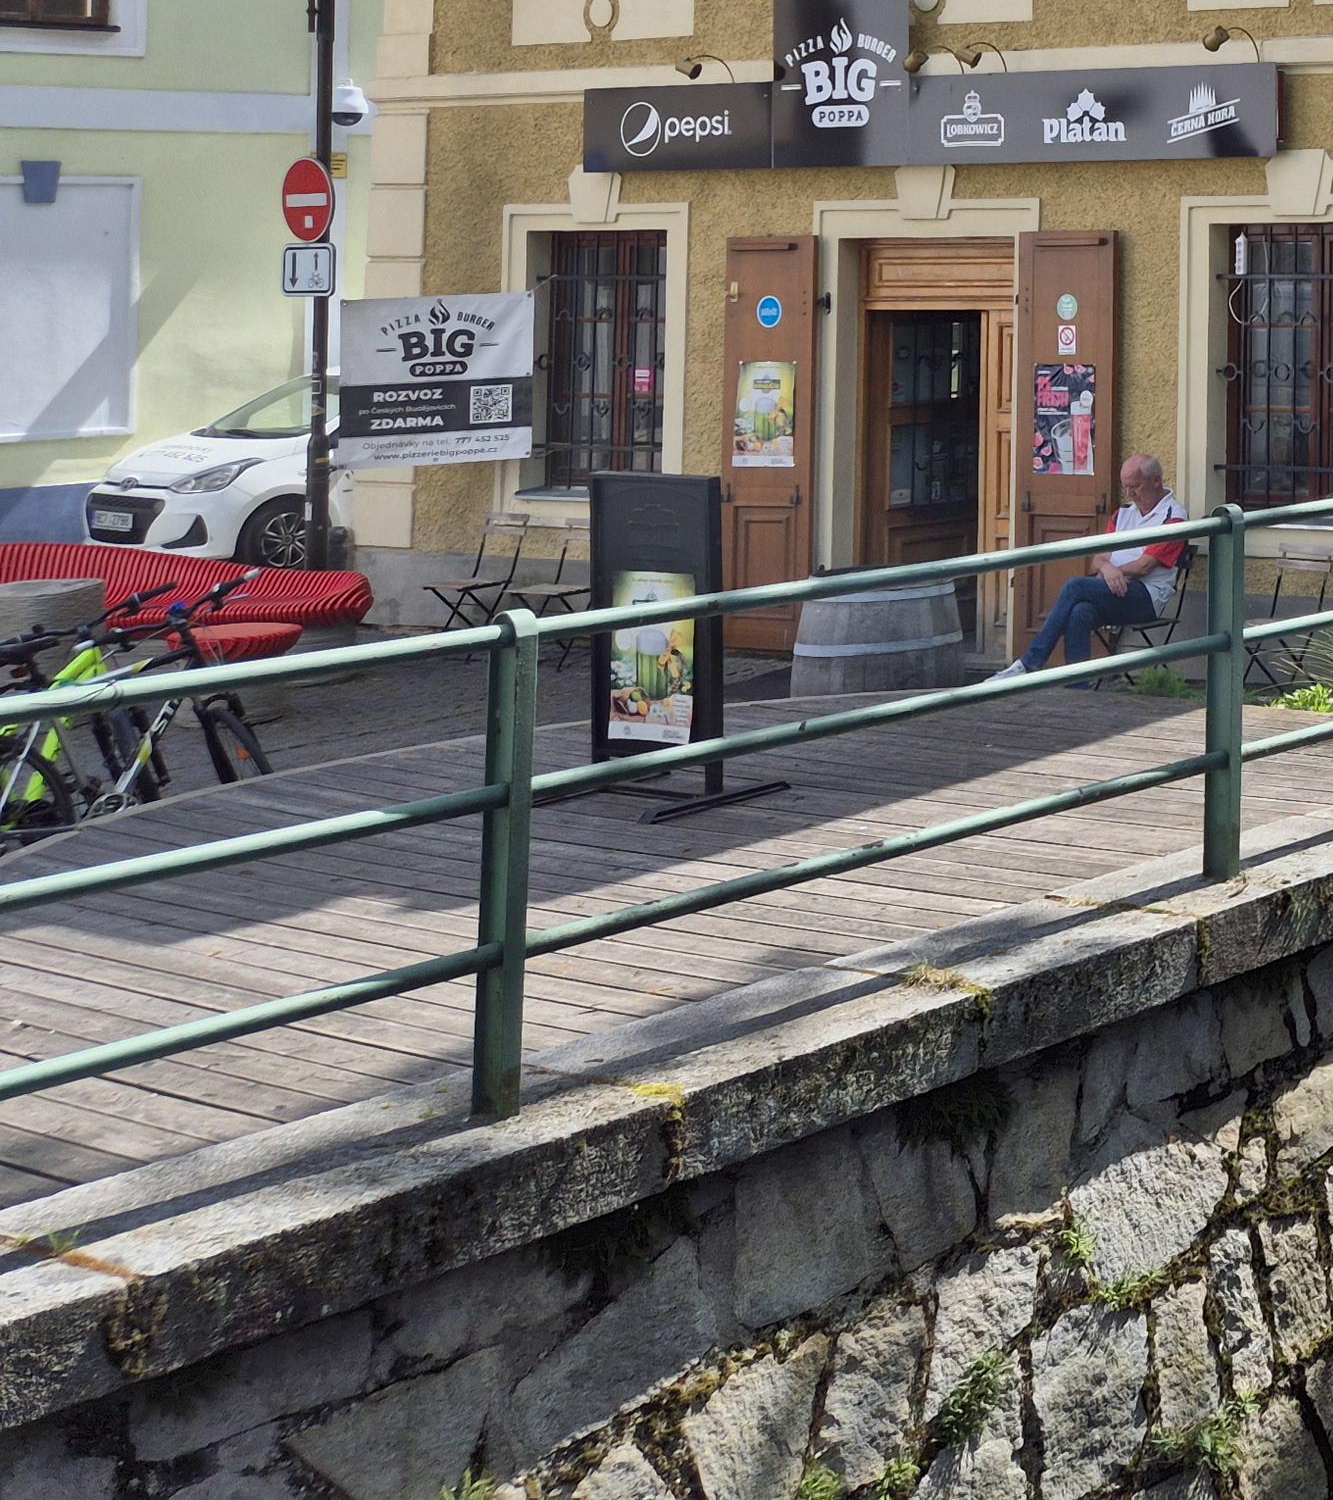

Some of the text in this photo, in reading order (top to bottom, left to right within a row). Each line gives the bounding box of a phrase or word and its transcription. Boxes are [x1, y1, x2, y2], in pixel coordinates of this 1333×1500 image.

[784, 33, 897, 68] PIZZA BURGER
[800, 56, 878, 106] BIG
[664, 110, 731, 144] pepsi
[817, 110, 864, 124] POPPA
[1207, 105, 1237, 126] HORA
[946, 122, 999, 138] LOBKOWICZ
[1042, 117, 1128, 144] Platan
[380, 311, 496, 336] PIZZA BURGER
[398, 328, 476, 362] BIG
[415, 363, 463, 374] POPPA
[372, 388, 443, 403] ROZVOZ
[370, 415, 444, 430] ZDARMA
